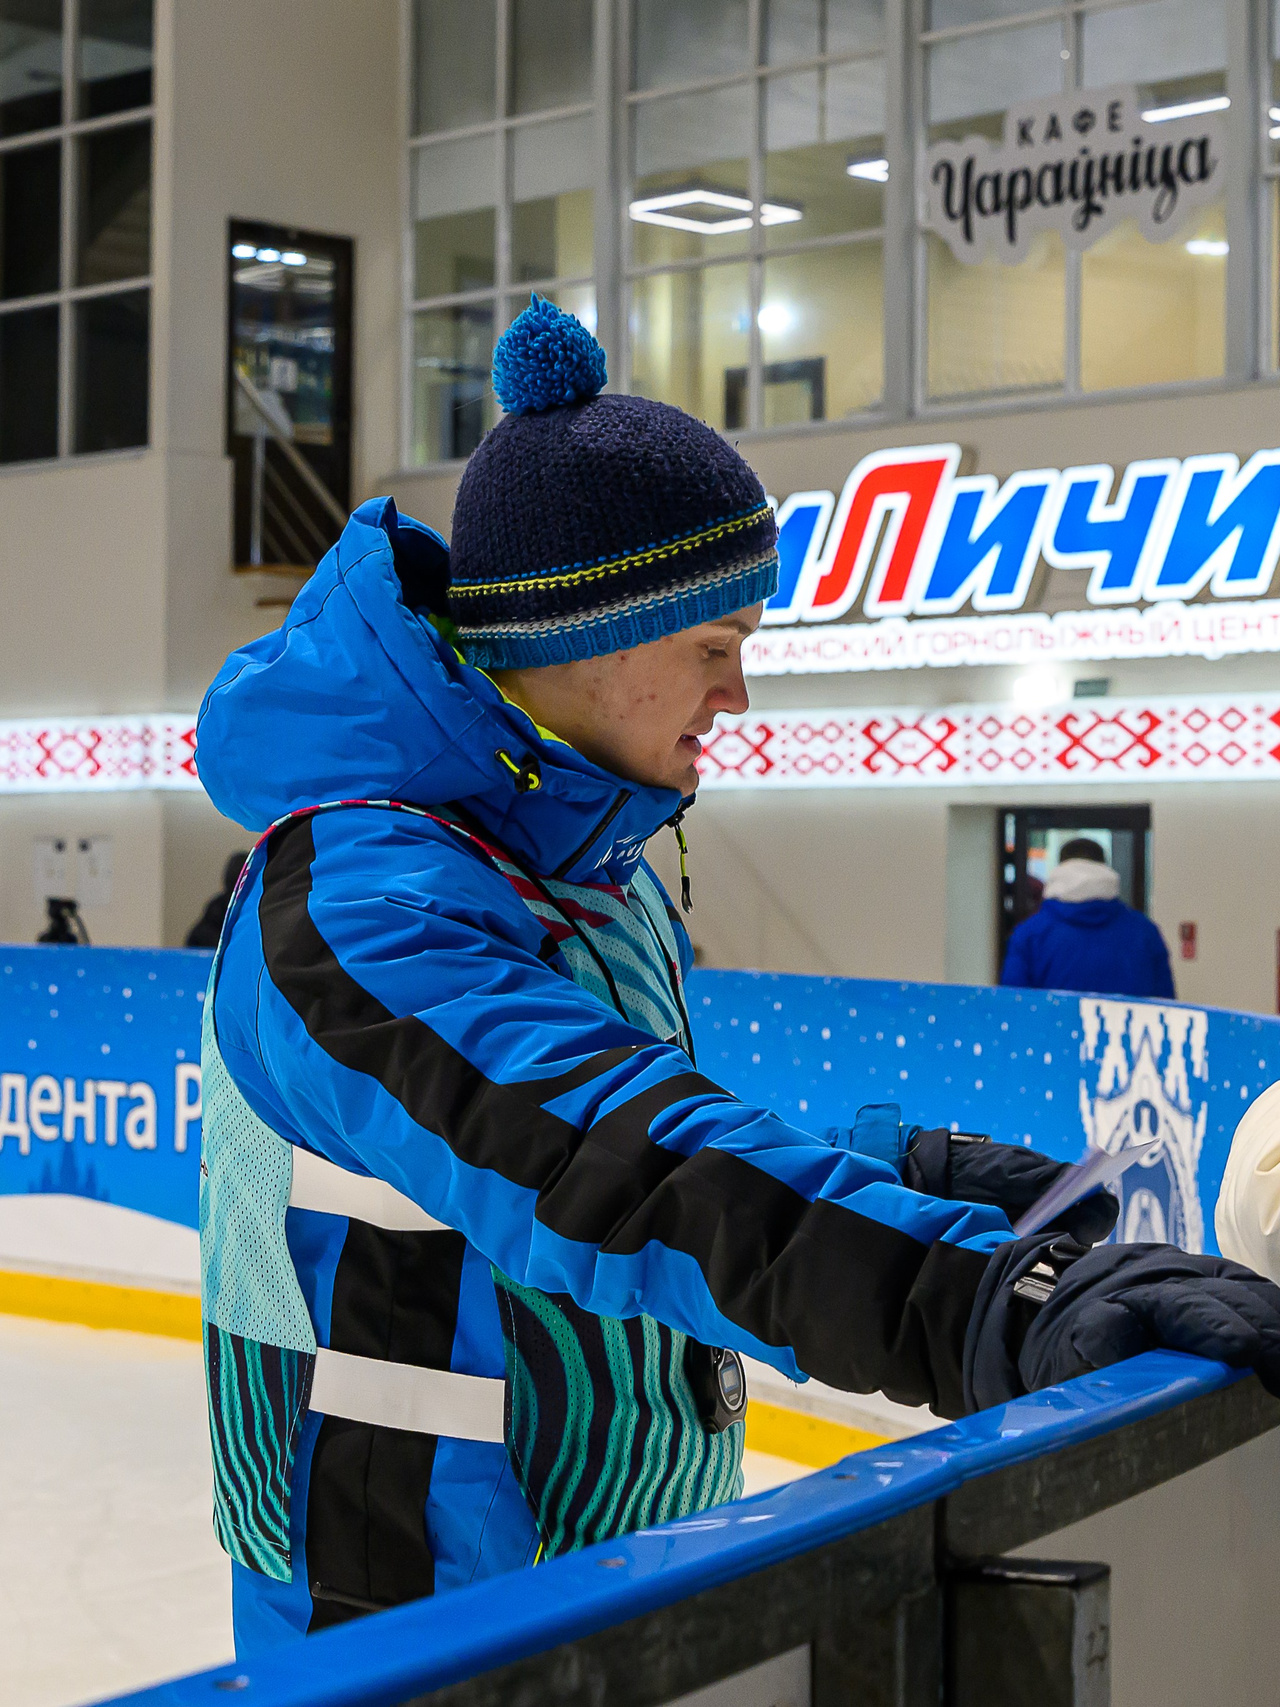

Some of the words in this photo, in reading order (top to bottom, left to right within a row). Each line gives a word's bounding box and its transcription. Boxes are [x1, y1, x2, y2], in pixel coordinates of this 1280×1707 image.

[1015, 100, 1124, 147] КАФЕ
[915, 610, 1183, 656] ГОРНОЛЫЖНЫЙ
[0, 1072, 157, 1156] дента
